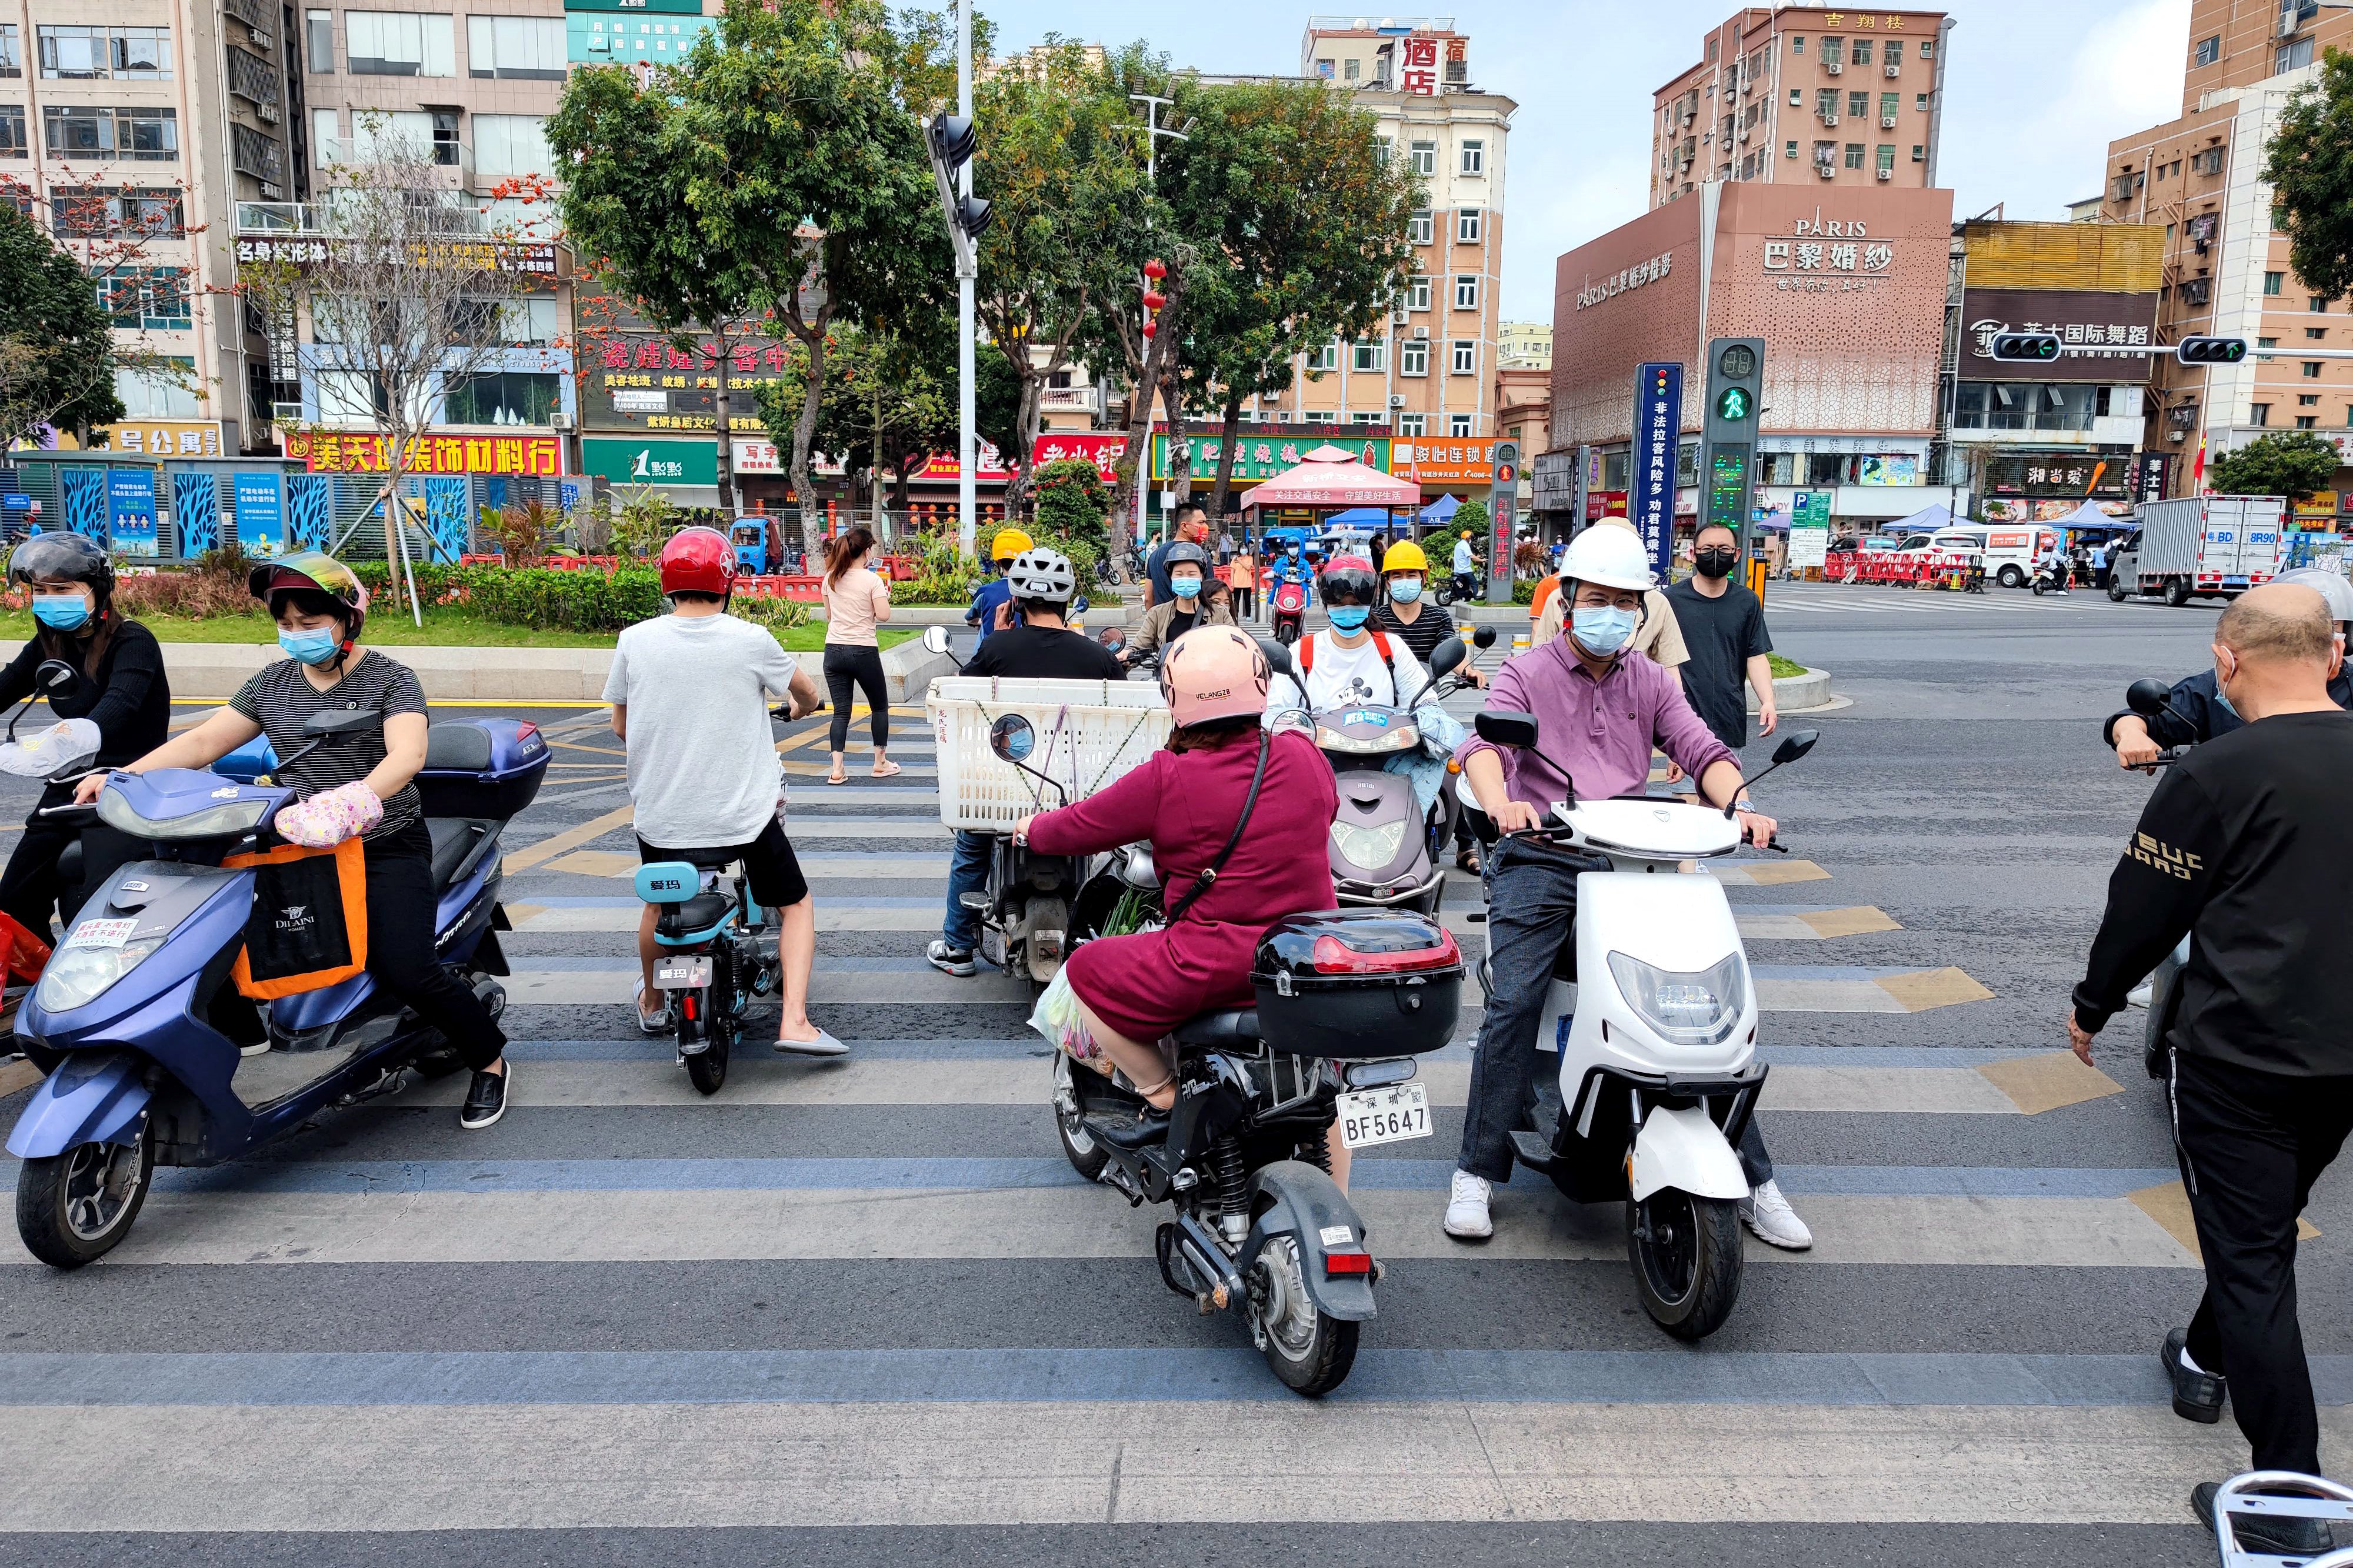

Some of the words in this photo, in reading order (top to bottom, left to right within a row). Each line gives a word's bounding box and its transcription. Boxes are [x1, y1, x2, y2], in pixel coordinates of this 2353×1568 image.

[1824, 12, 1905, 29] 吉翔楼
[593, 37, 700, 51] 产后康复培
[1404, 38, 1437, 96] 酒店
[1795, 205, 1867, 237] PARIS
[1577, 273, 1607, 311] PARIS
[204, 429, 218, 456] 写字
[1650, 402, 1668, 495] 非法拉客风险多
[1757, 439, 1888, 452] 美容美发养生
[1275, 490, 1331, 501] 关注交通安全
[1345, 490, 1401, 501] 守望美好生活
[1797, 494, 1807, 507] P
[1646, 499, 1662, 565] 劝君莫乘坐
[2218, 532, 2232, 542] BD
[2250, 533, 2275, 543] 8R90
[650, 880, 681, 890] 爱玛
[275, 916, 315, 929] DILAINI
[659, 969, 688, 979] 爱玛
[1367, 1094, 1398, 1109] 深圳
[1345, 1107, 1425, 1142] BF5647
